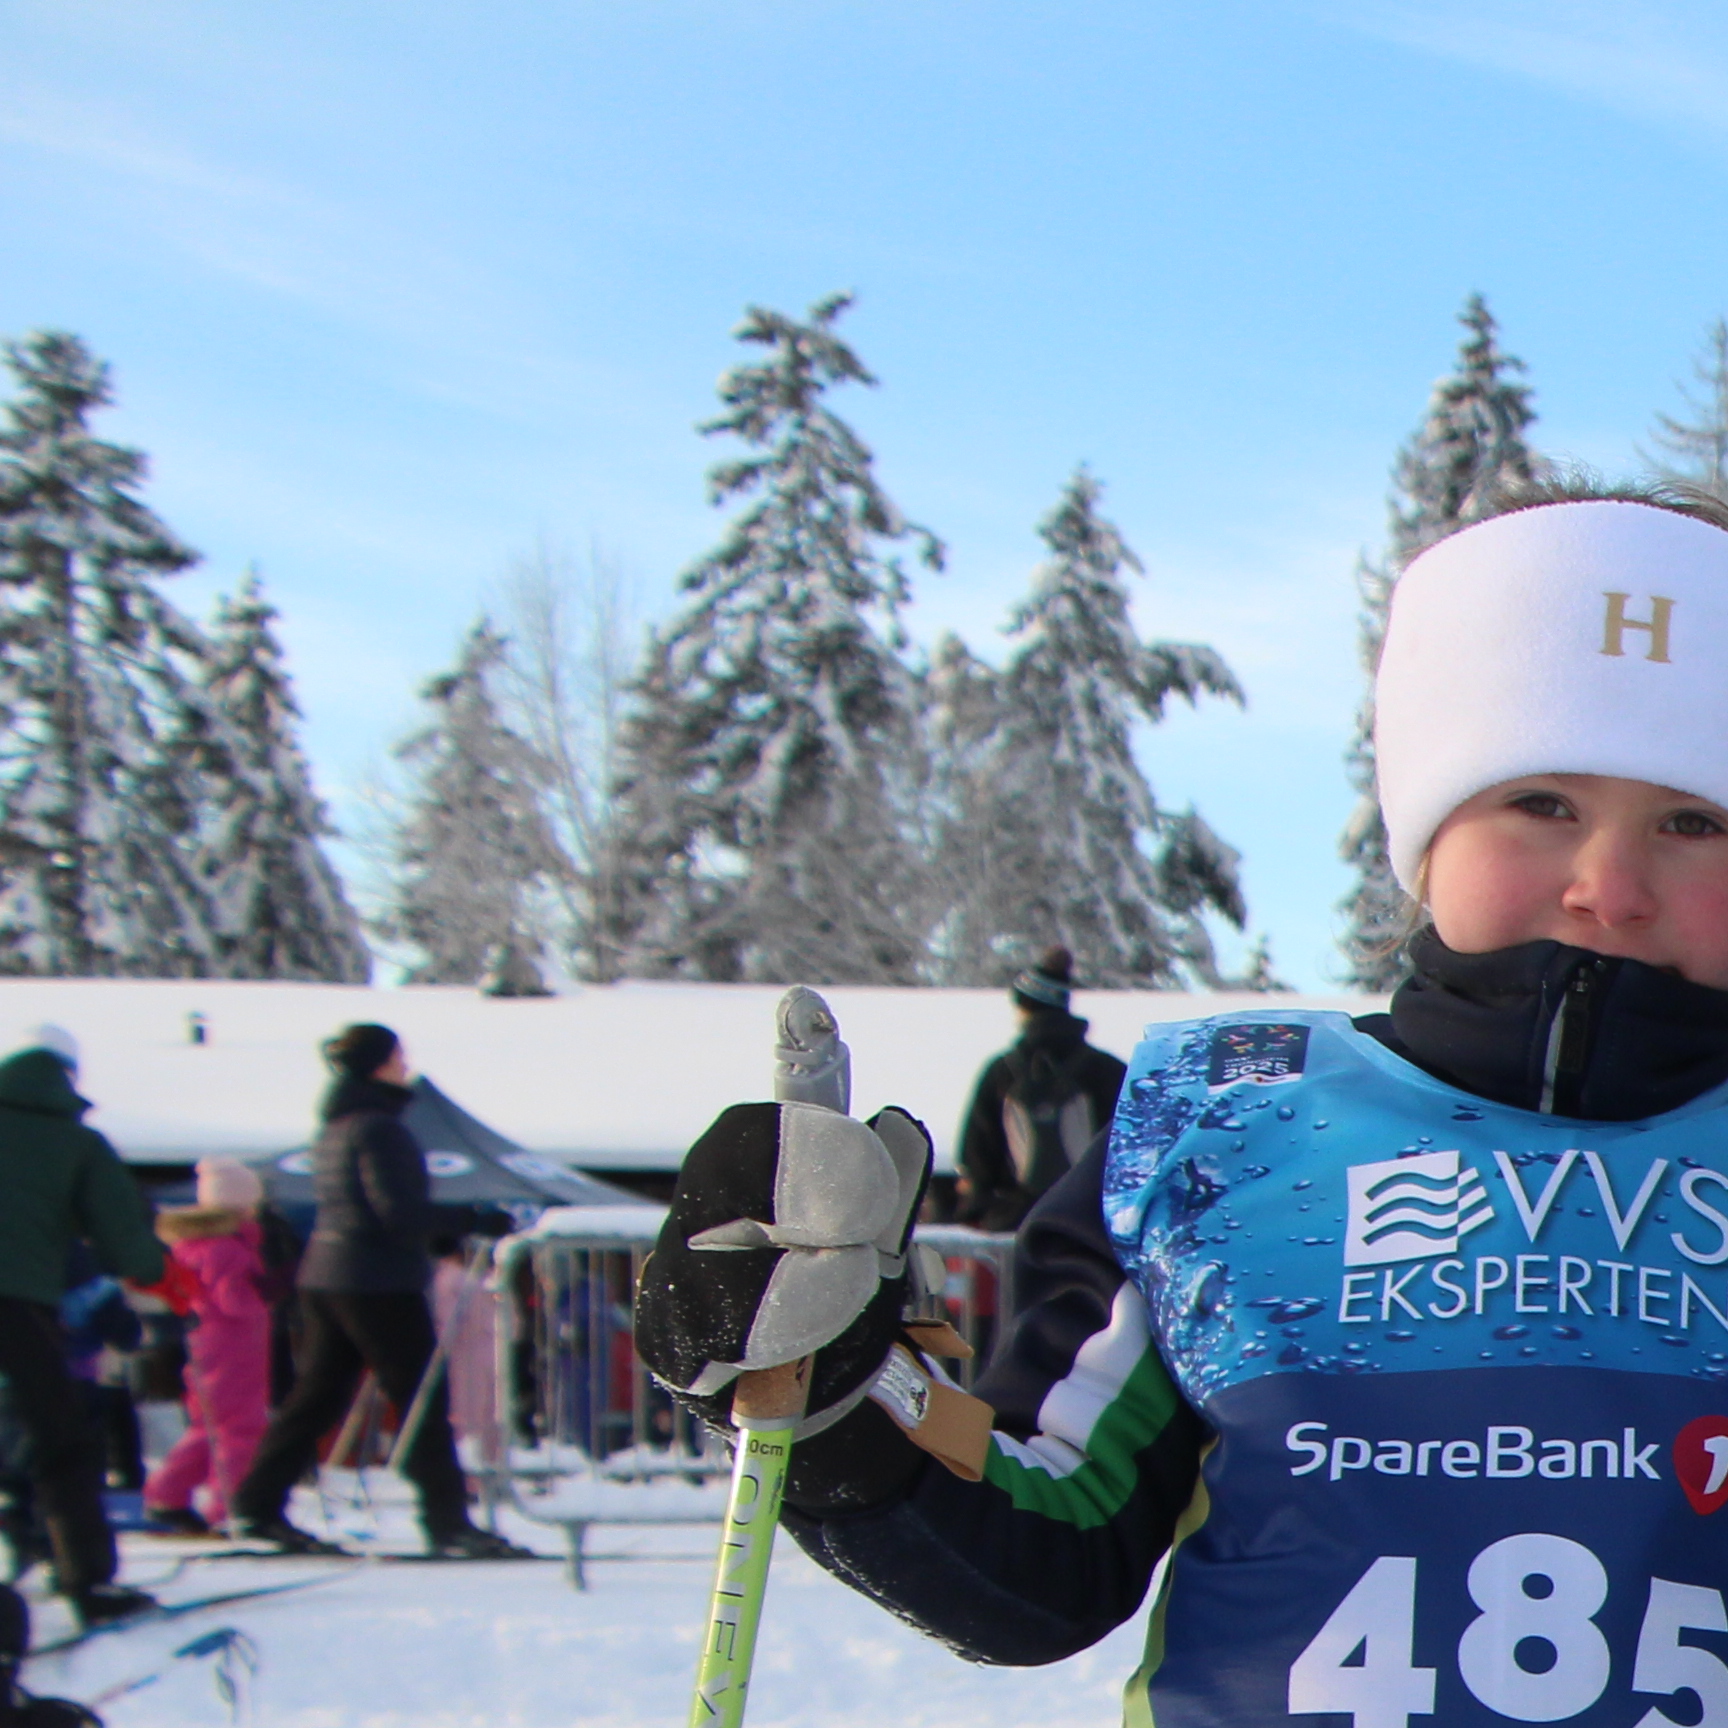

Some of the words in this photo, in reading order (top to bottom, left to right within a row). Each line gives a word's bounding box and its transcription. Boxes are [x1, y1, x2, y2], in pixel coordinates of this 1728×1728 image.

[1598, 592, 1677, 663] H
[1222, 1060, 1290, 1080] 2025
[748, 1439, 784, 1457] 0cm
[1285, 1421, 1662, 1481] SpareBank
